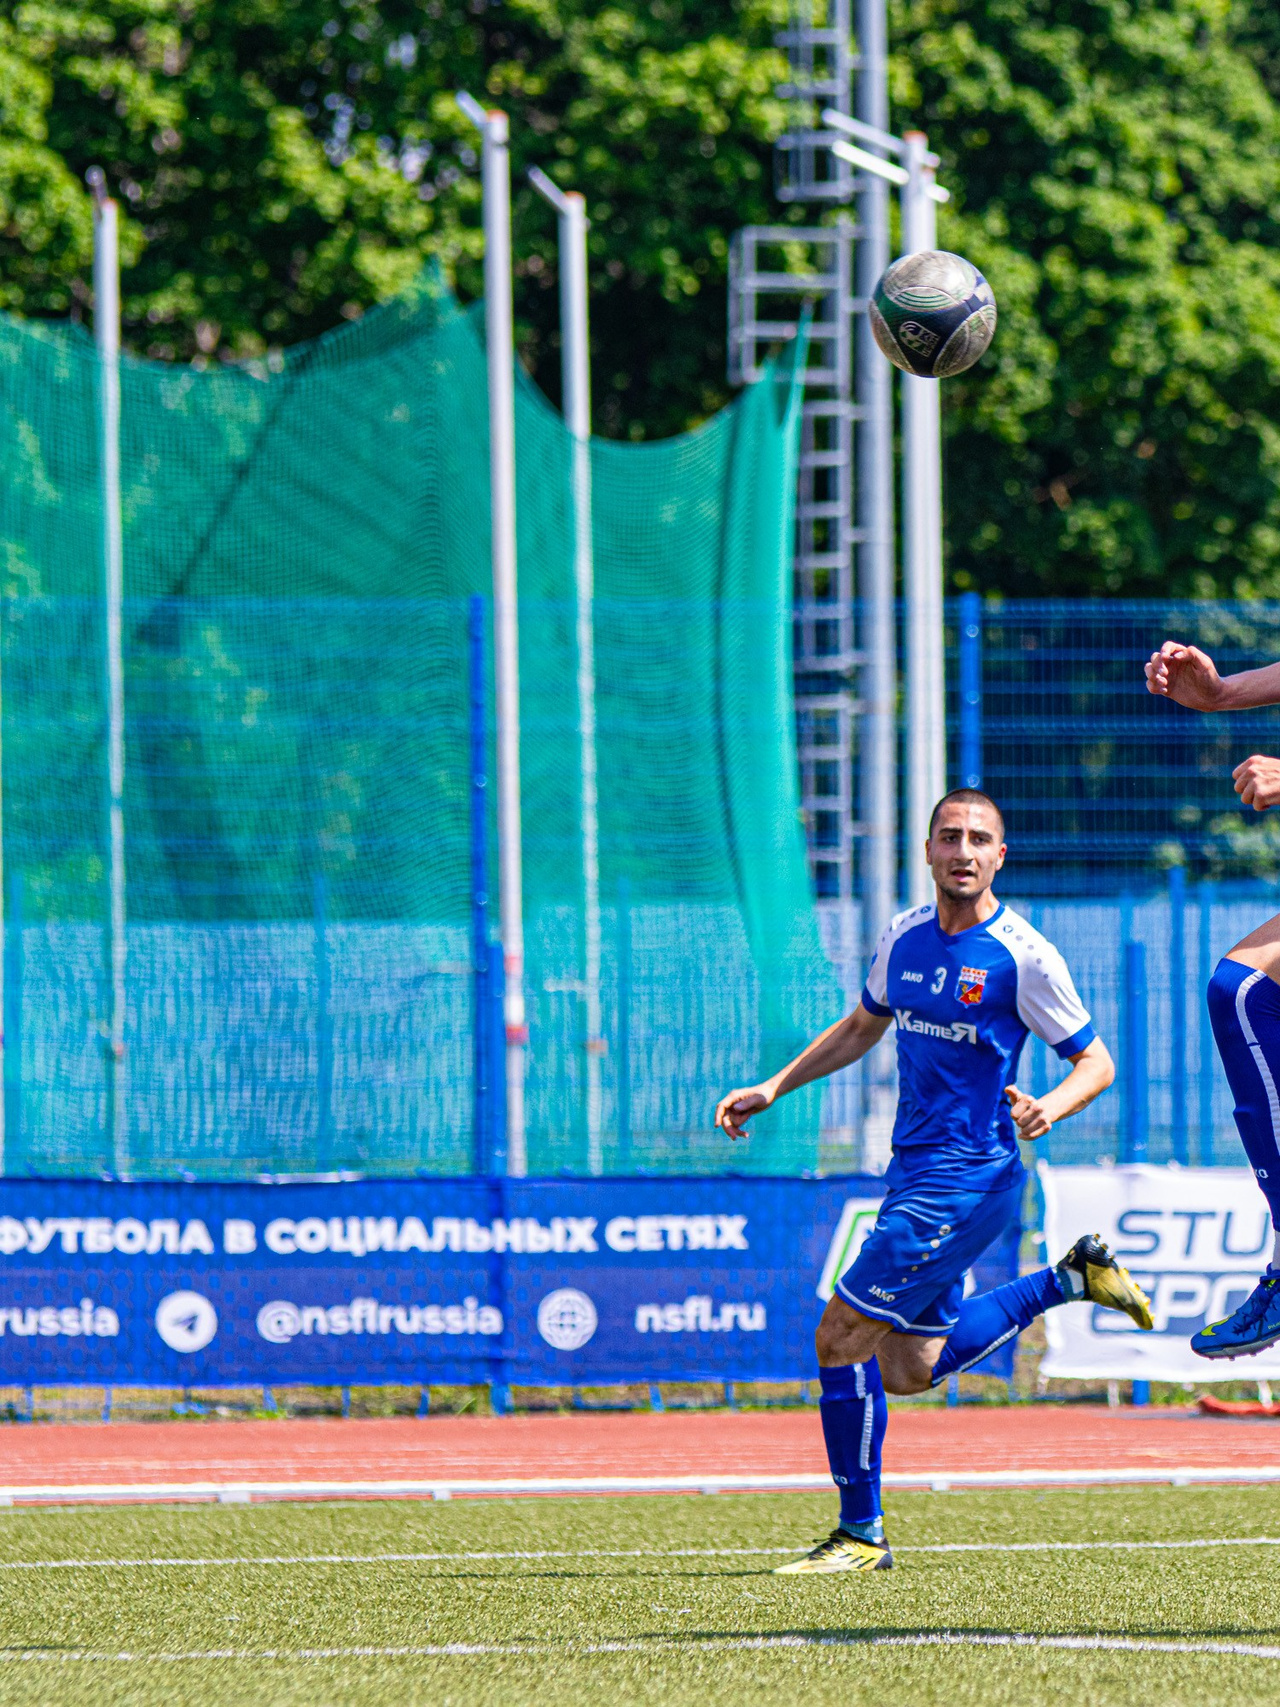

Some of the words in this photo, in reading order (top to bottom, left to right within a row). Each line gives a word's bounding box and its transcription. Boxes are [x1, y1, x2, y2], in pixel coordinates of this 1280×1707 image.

[901, 971, 923, 983] JAKO
[930, 966, 947, 995] 3
[223, 1218, 257, 1254] В
[264, 1215, 599, 1257] СОЦИАЛЬНЫХ
[604, 1214, 749, 1252] СЕТЯХ
[868, 1285, 895, 1302] JAKO
[635, 1295, 767, 1333] nsfl.ru
